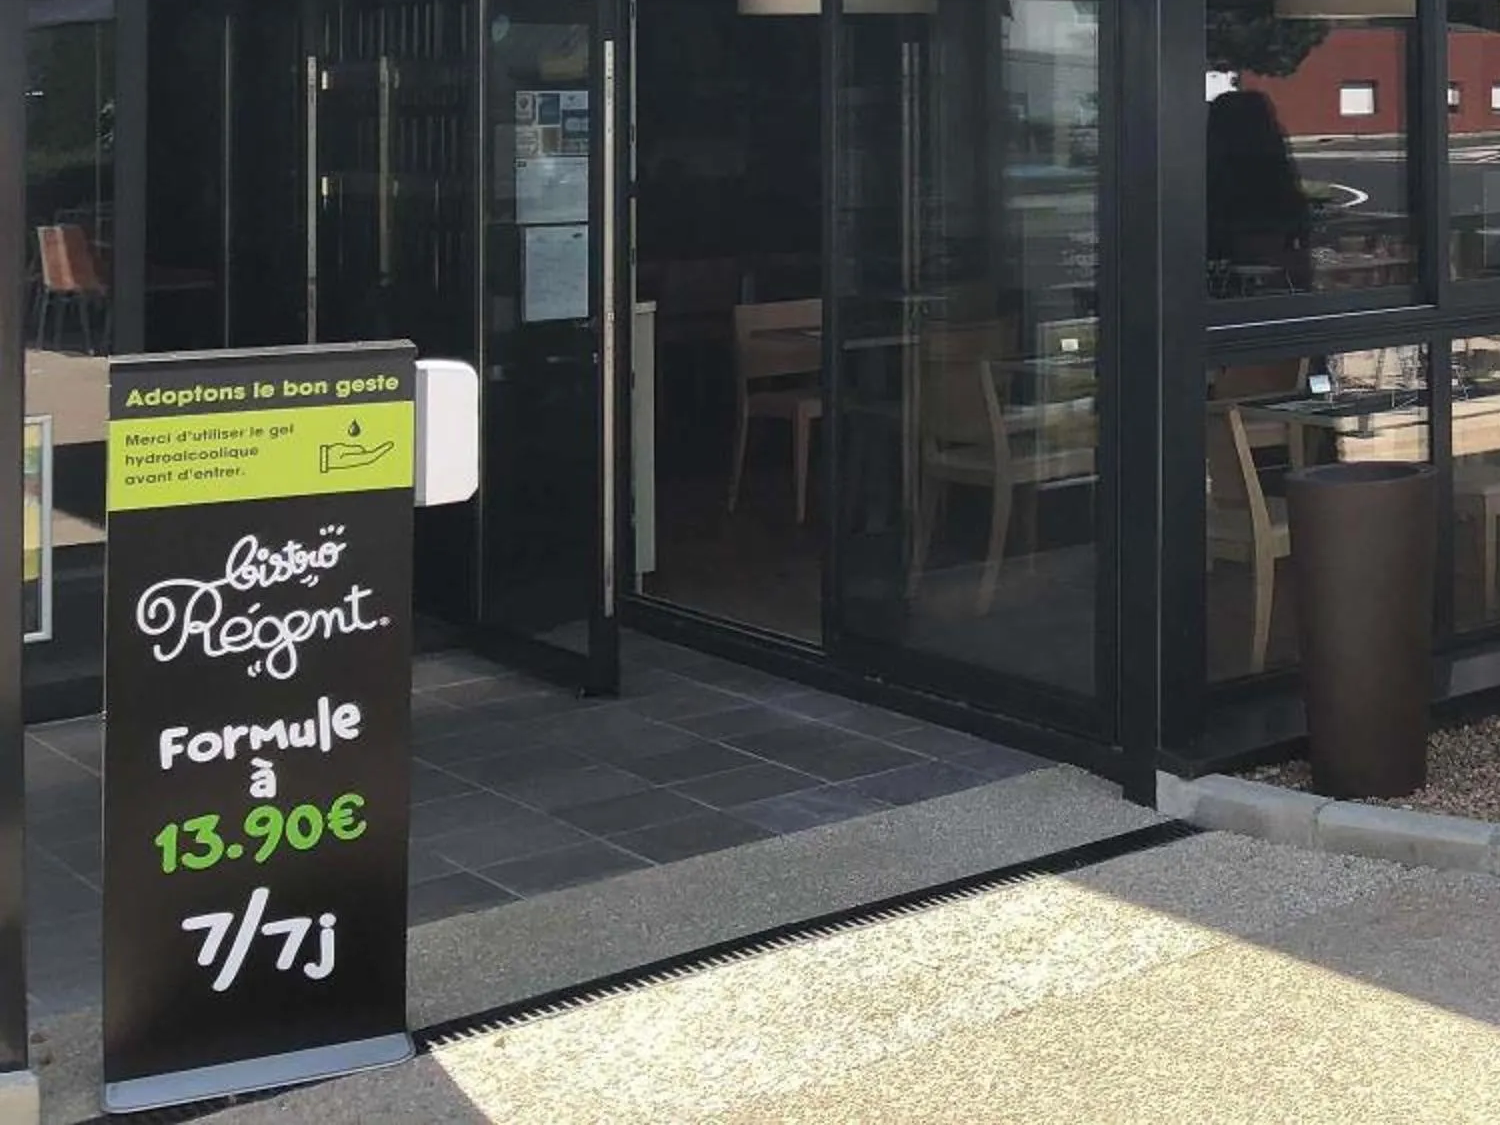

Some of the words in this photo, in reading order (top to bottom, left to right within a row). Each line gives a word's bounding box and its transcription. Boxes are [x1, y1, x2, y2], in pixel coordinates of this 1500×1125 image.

[125, 385, 246, 407] Adoptons
[253, 381, 276, 399] le
[283, 379, 328, 397] bon
[335, 374, 400, 398] geste
[125, 432, 171, 447] Merci
[176, 428, 244, 443] d'utiliser
[249, 426, 265, 438] le
[269, 423, 294, 439] gel
[125, 448, 259, 468] hydroalcoolique
[125, 470, 173, 486] avant
[178, 466, 246, 480] d'entrer.
[159, 696, 362, 770] Formule
[249, 757, 277, 799] à
[154, 793, 368, 874] 13.90€
[181, 887, 337, 992] 7/7j
